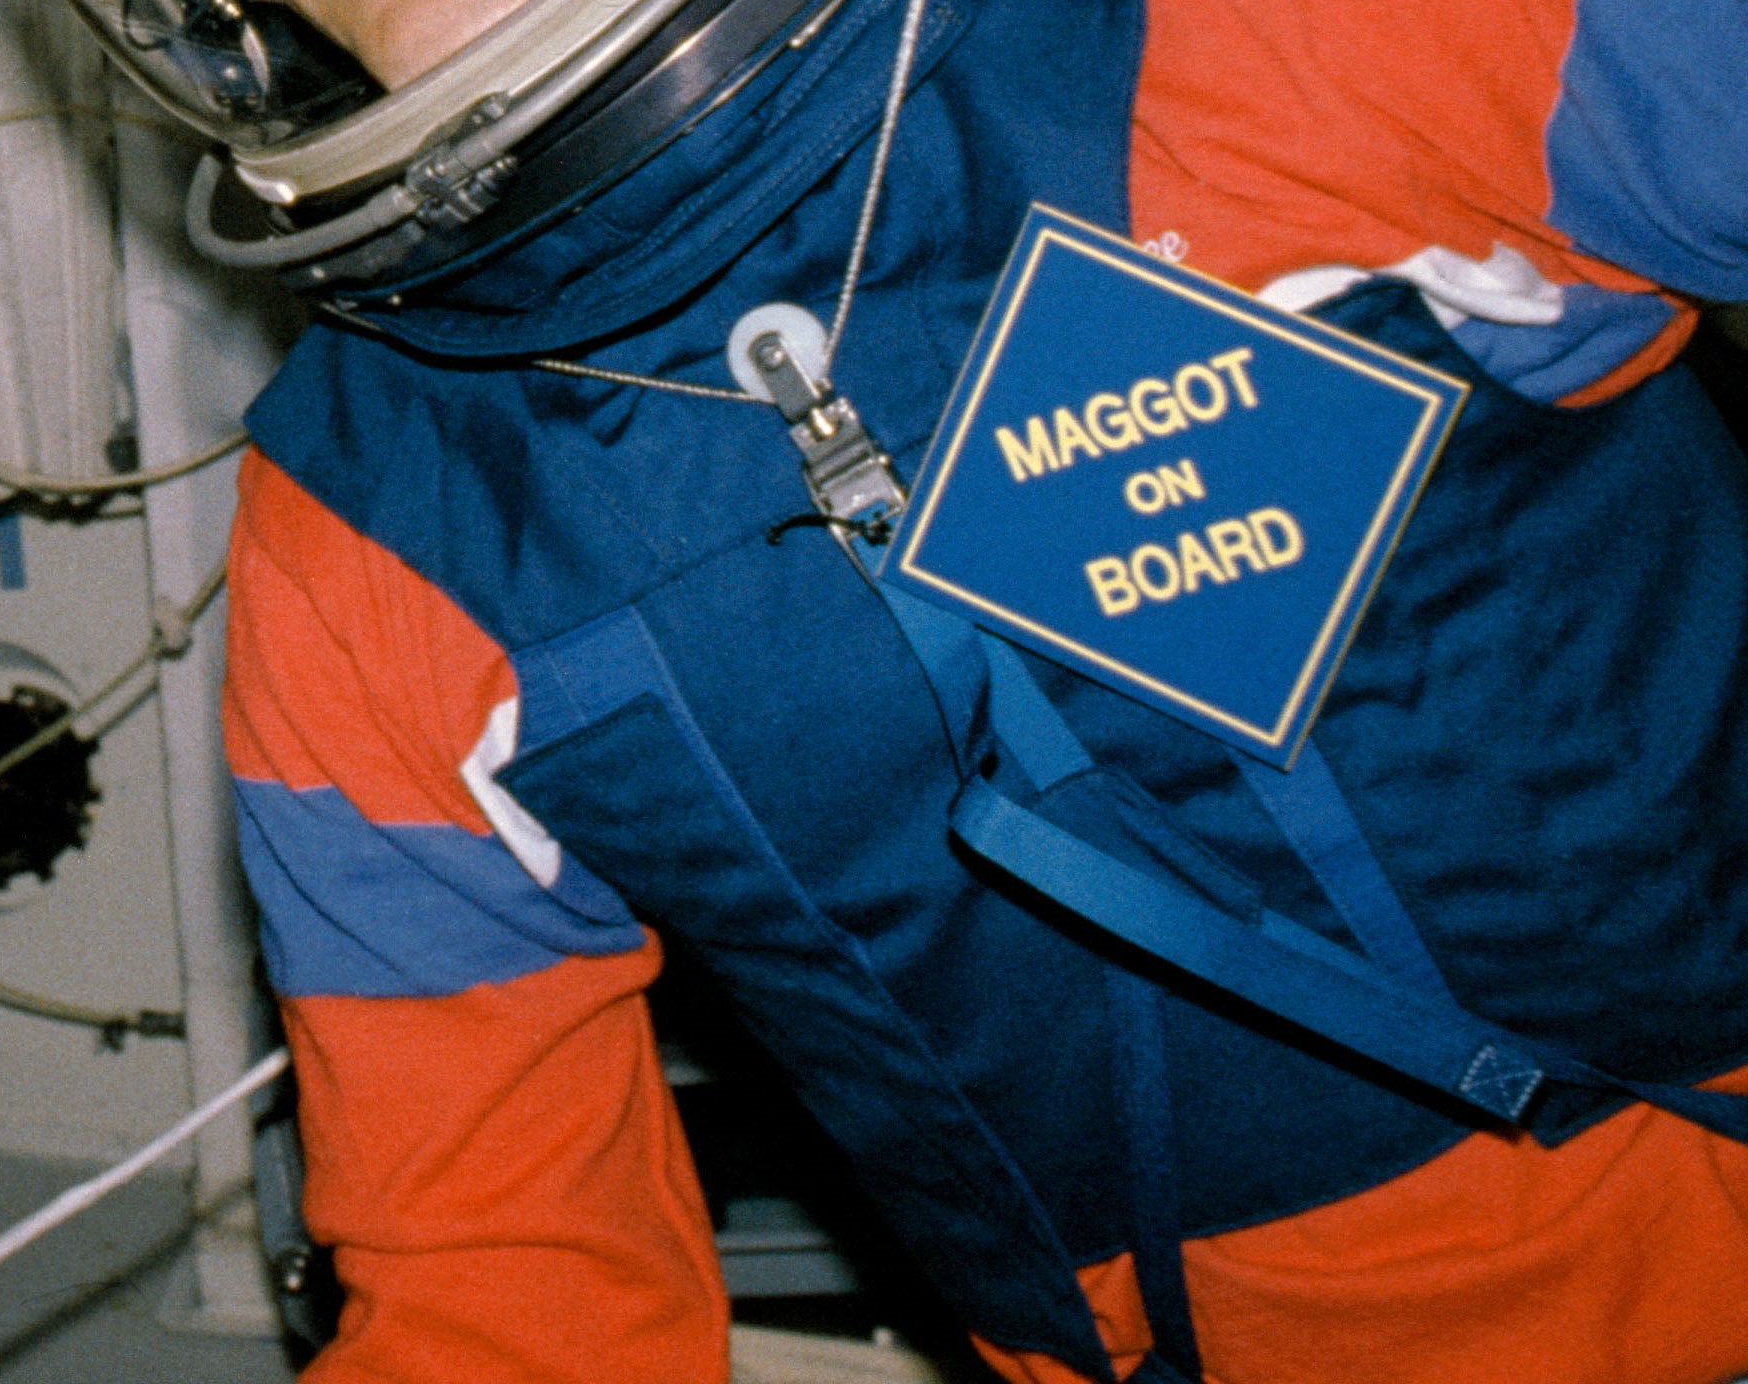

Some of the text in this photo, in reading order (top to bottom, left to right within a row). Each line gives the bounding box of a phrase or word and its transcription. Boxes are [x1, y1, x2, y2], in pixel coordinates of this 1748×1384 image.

[994, 347, 1259, 484] MAGGOT
[1123, 459, 1207, 515] ON
[1083, 507, 1305, 617] BOARD
